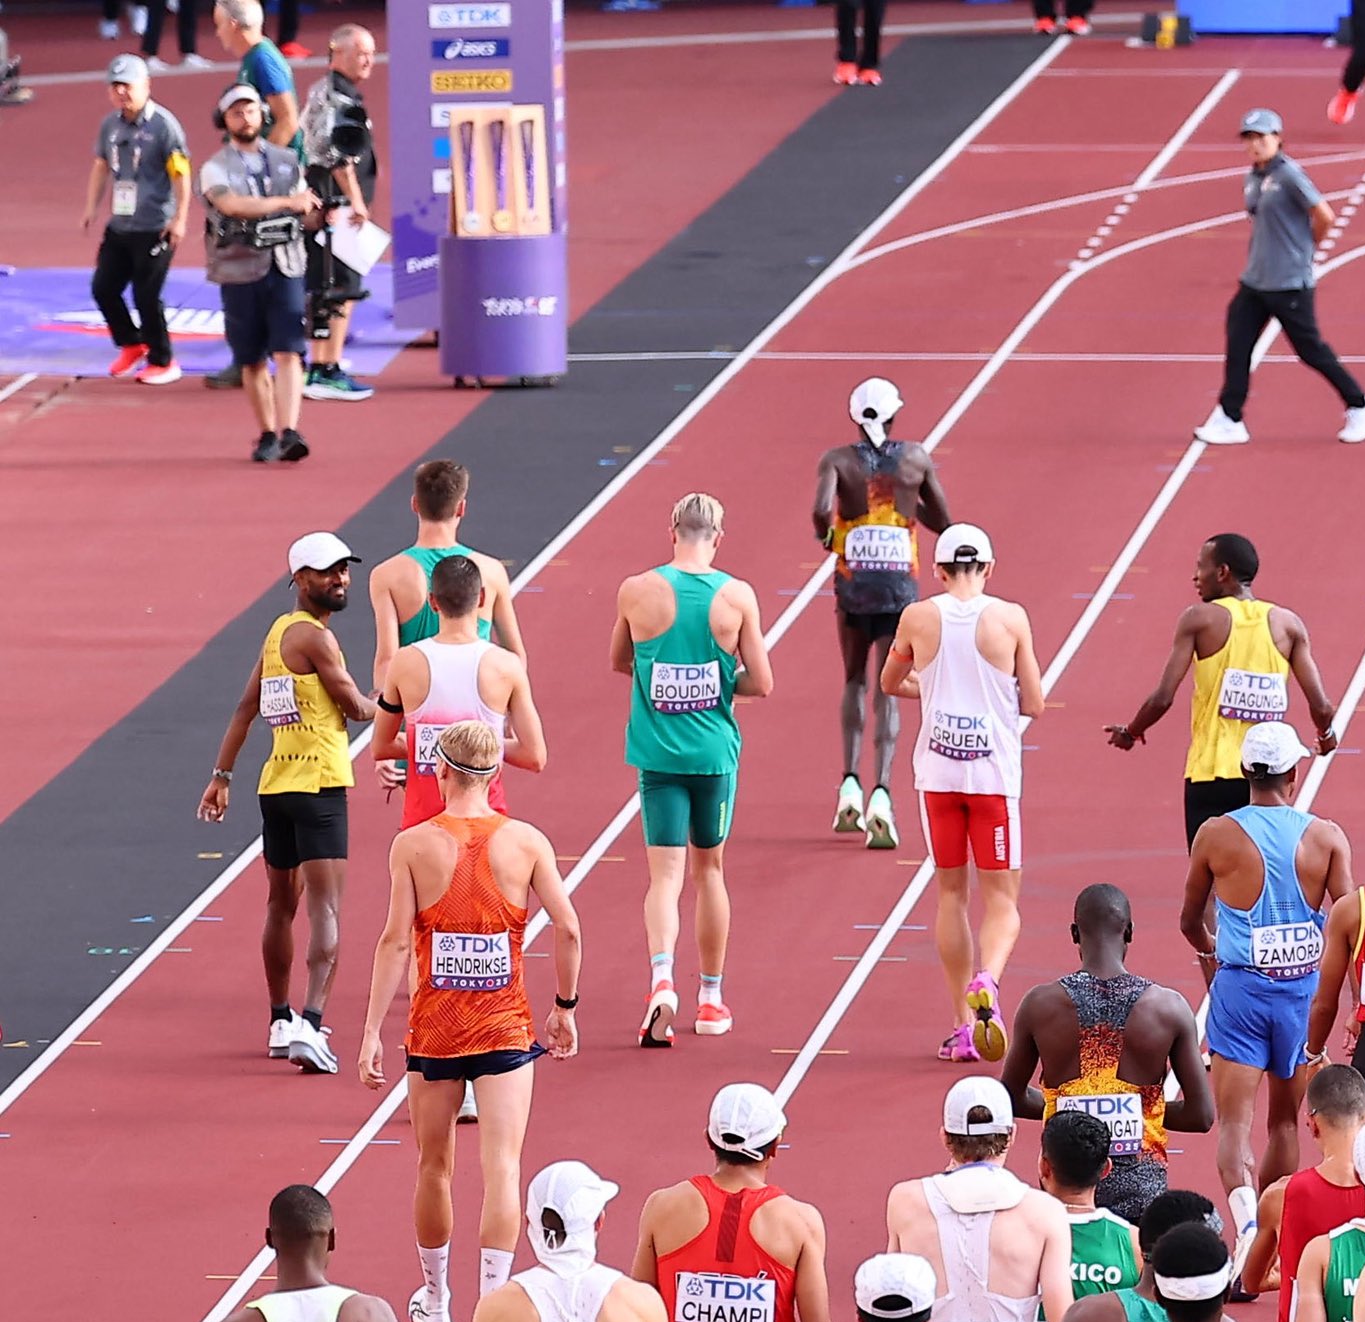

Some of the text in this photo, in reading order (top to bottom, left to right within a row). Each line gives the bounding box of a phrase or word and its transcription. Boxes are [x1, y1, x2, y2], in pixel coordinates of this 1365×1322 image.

[434, 71, 507, 91] SEIKO
[865, 529, 904, 543] TDK
[851, 544, 905, 559] MUTAI
[671, 665, 713, 680] TDK
[1244, 674, 1282, 689] TDK
[266, 679, 289, 695] TDK
[655, 684, 717, 701] BOUDIN
[1223, 690, 1286, 709] NTAGUNGA
[944, 714, 985, 730] TDK
[934, 727, 989, 748] GRUEN
[995, 825, 1005, 862] AUSTRIA
[1281, 921, 1319, 943] TDK
[456, 936, 503, 953] TDK
[1258, 940, 1322, 967] ZAMORA
[436, 955, 507, 976] HENDRIKSE
[1078, 1097, 1134, 1115] TDK
[1069, 1263, 1122, 1285] XICO
[704, 1279, 765, 1301] TDK
